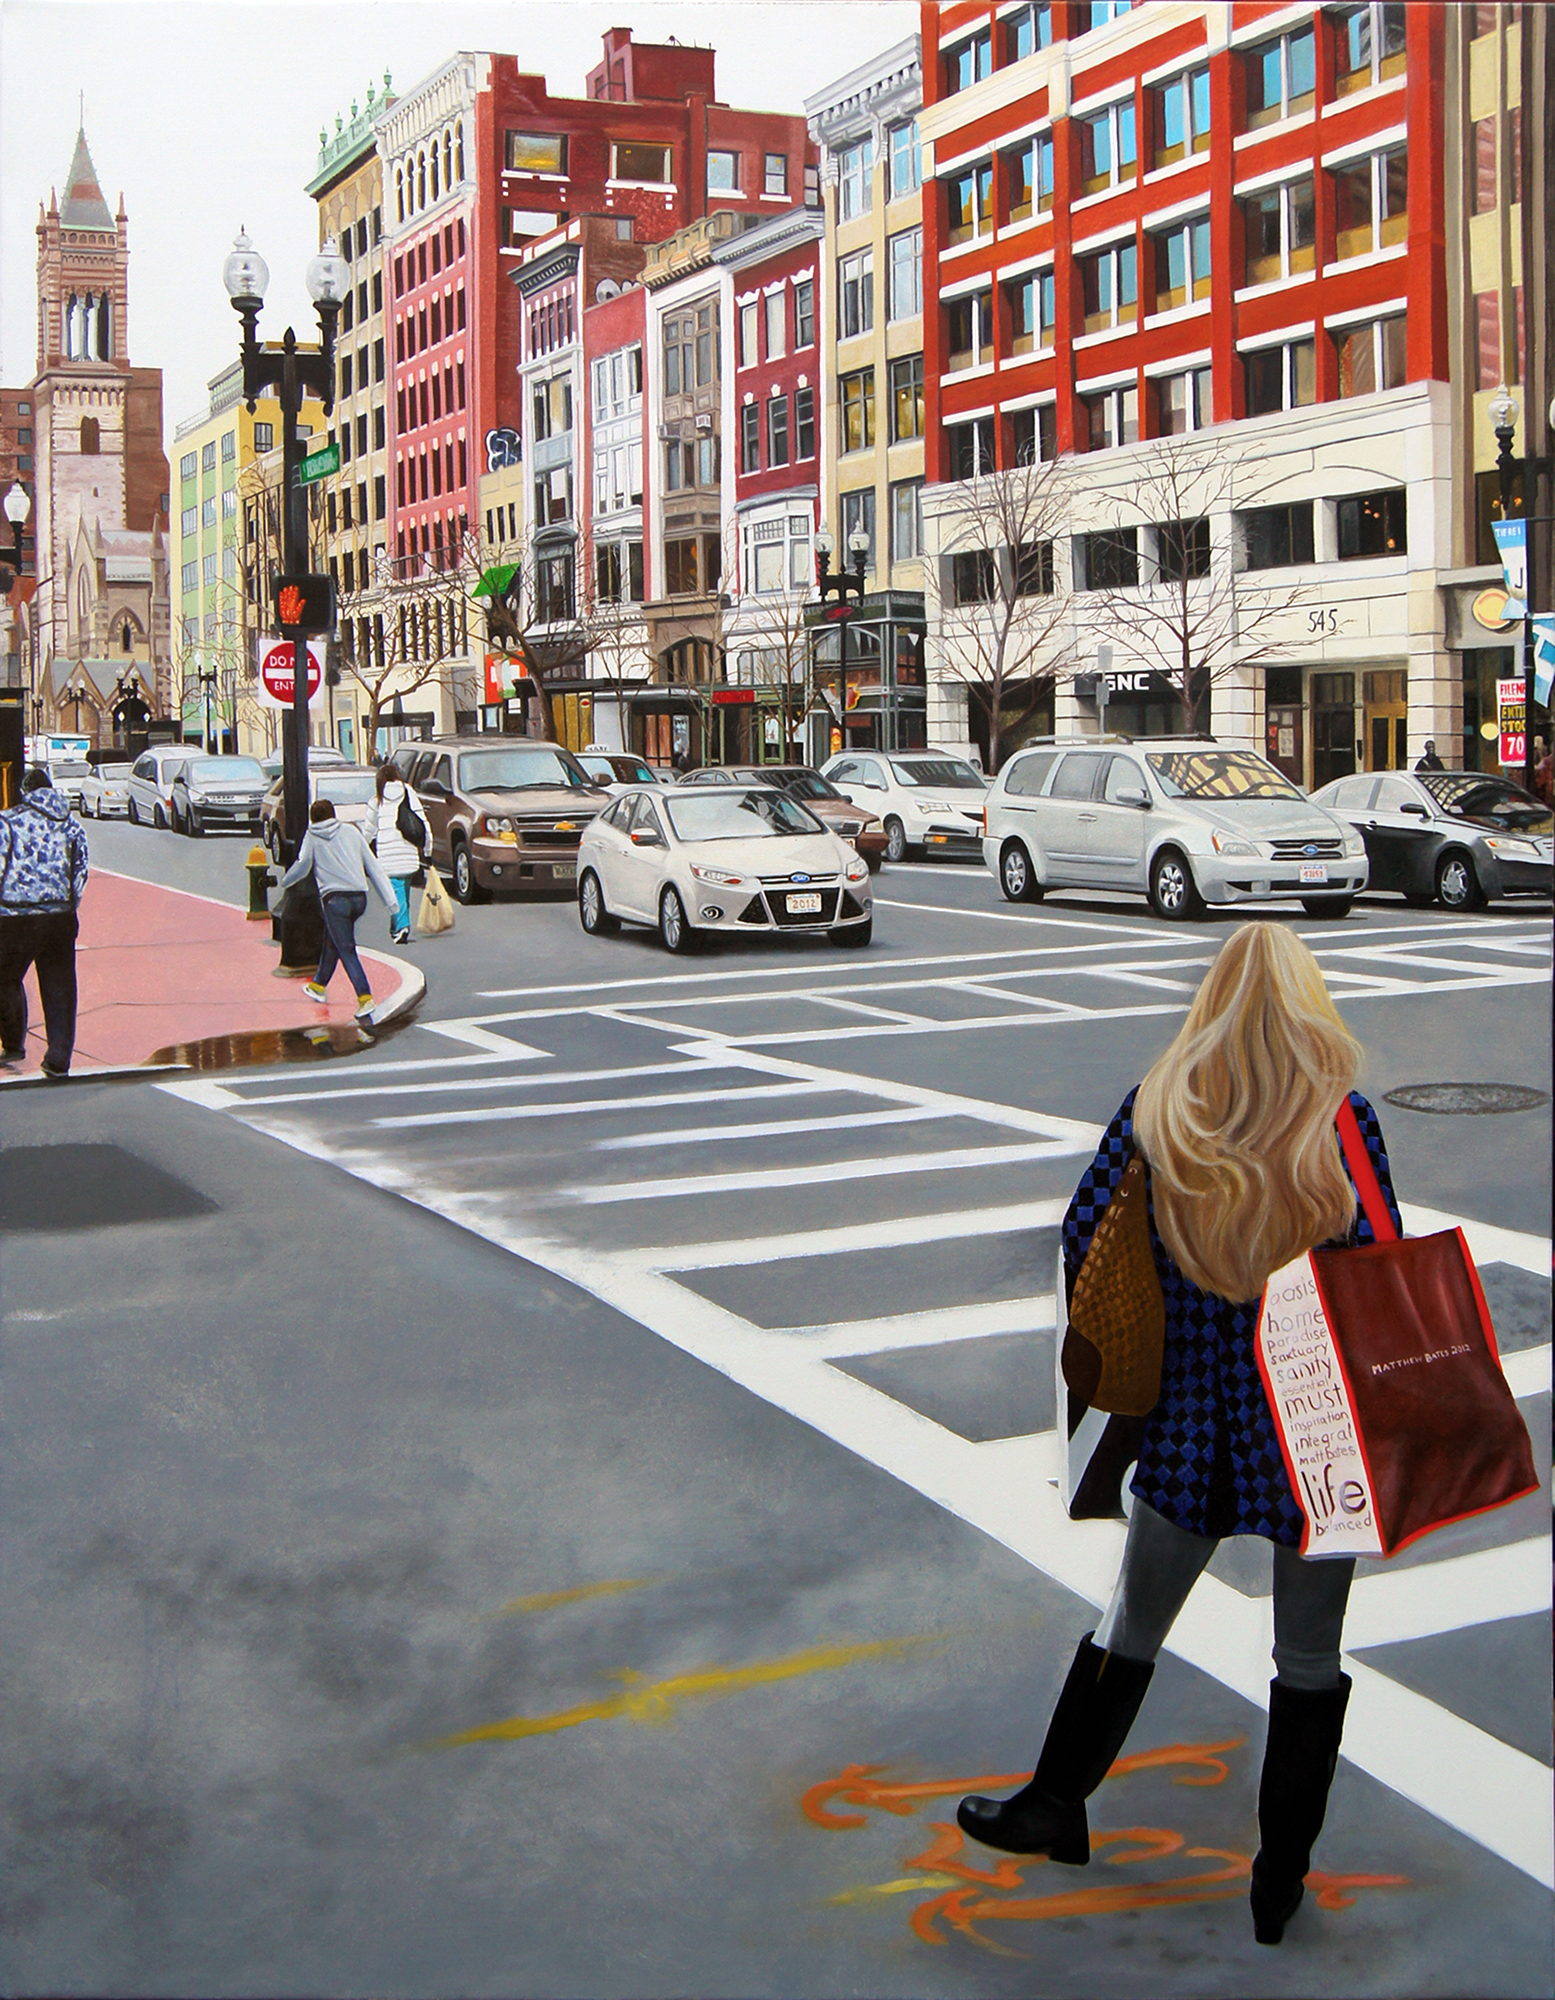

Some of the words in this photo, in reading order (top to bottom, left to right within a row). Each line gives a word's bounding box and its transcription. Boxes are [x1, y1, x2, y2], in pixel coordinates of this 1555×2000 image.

[1307, 608, 1338, 632] 545
[269, 655, 287, 667] DO
[274, 680, 295, 691] ENT
[1105, 673, 1150, 691] GNC
[1507, 735, 1524, 755] 70
[792, 899, 816, 909] 2012
[1270, 1276, 1317, 1306] oasis
[1267, 1308, 1325, 1334] home
[1266, 1328, 1327, 1354] paradise
[1276, 1353, 1332, 1384] sanity
[1371, 1357, 1422, 1375] MATTHEW
[1424, 1349, 1449, 1364] BATES
[1451, 1343, 1471, 1355] 2012
[1281, 1376, 1329, 1397] essential
[1284, 1382, 1343, 1419] must
[1295, 1422, 1352, 1453] integral
[1301, 1463, 1367, 1520] life
